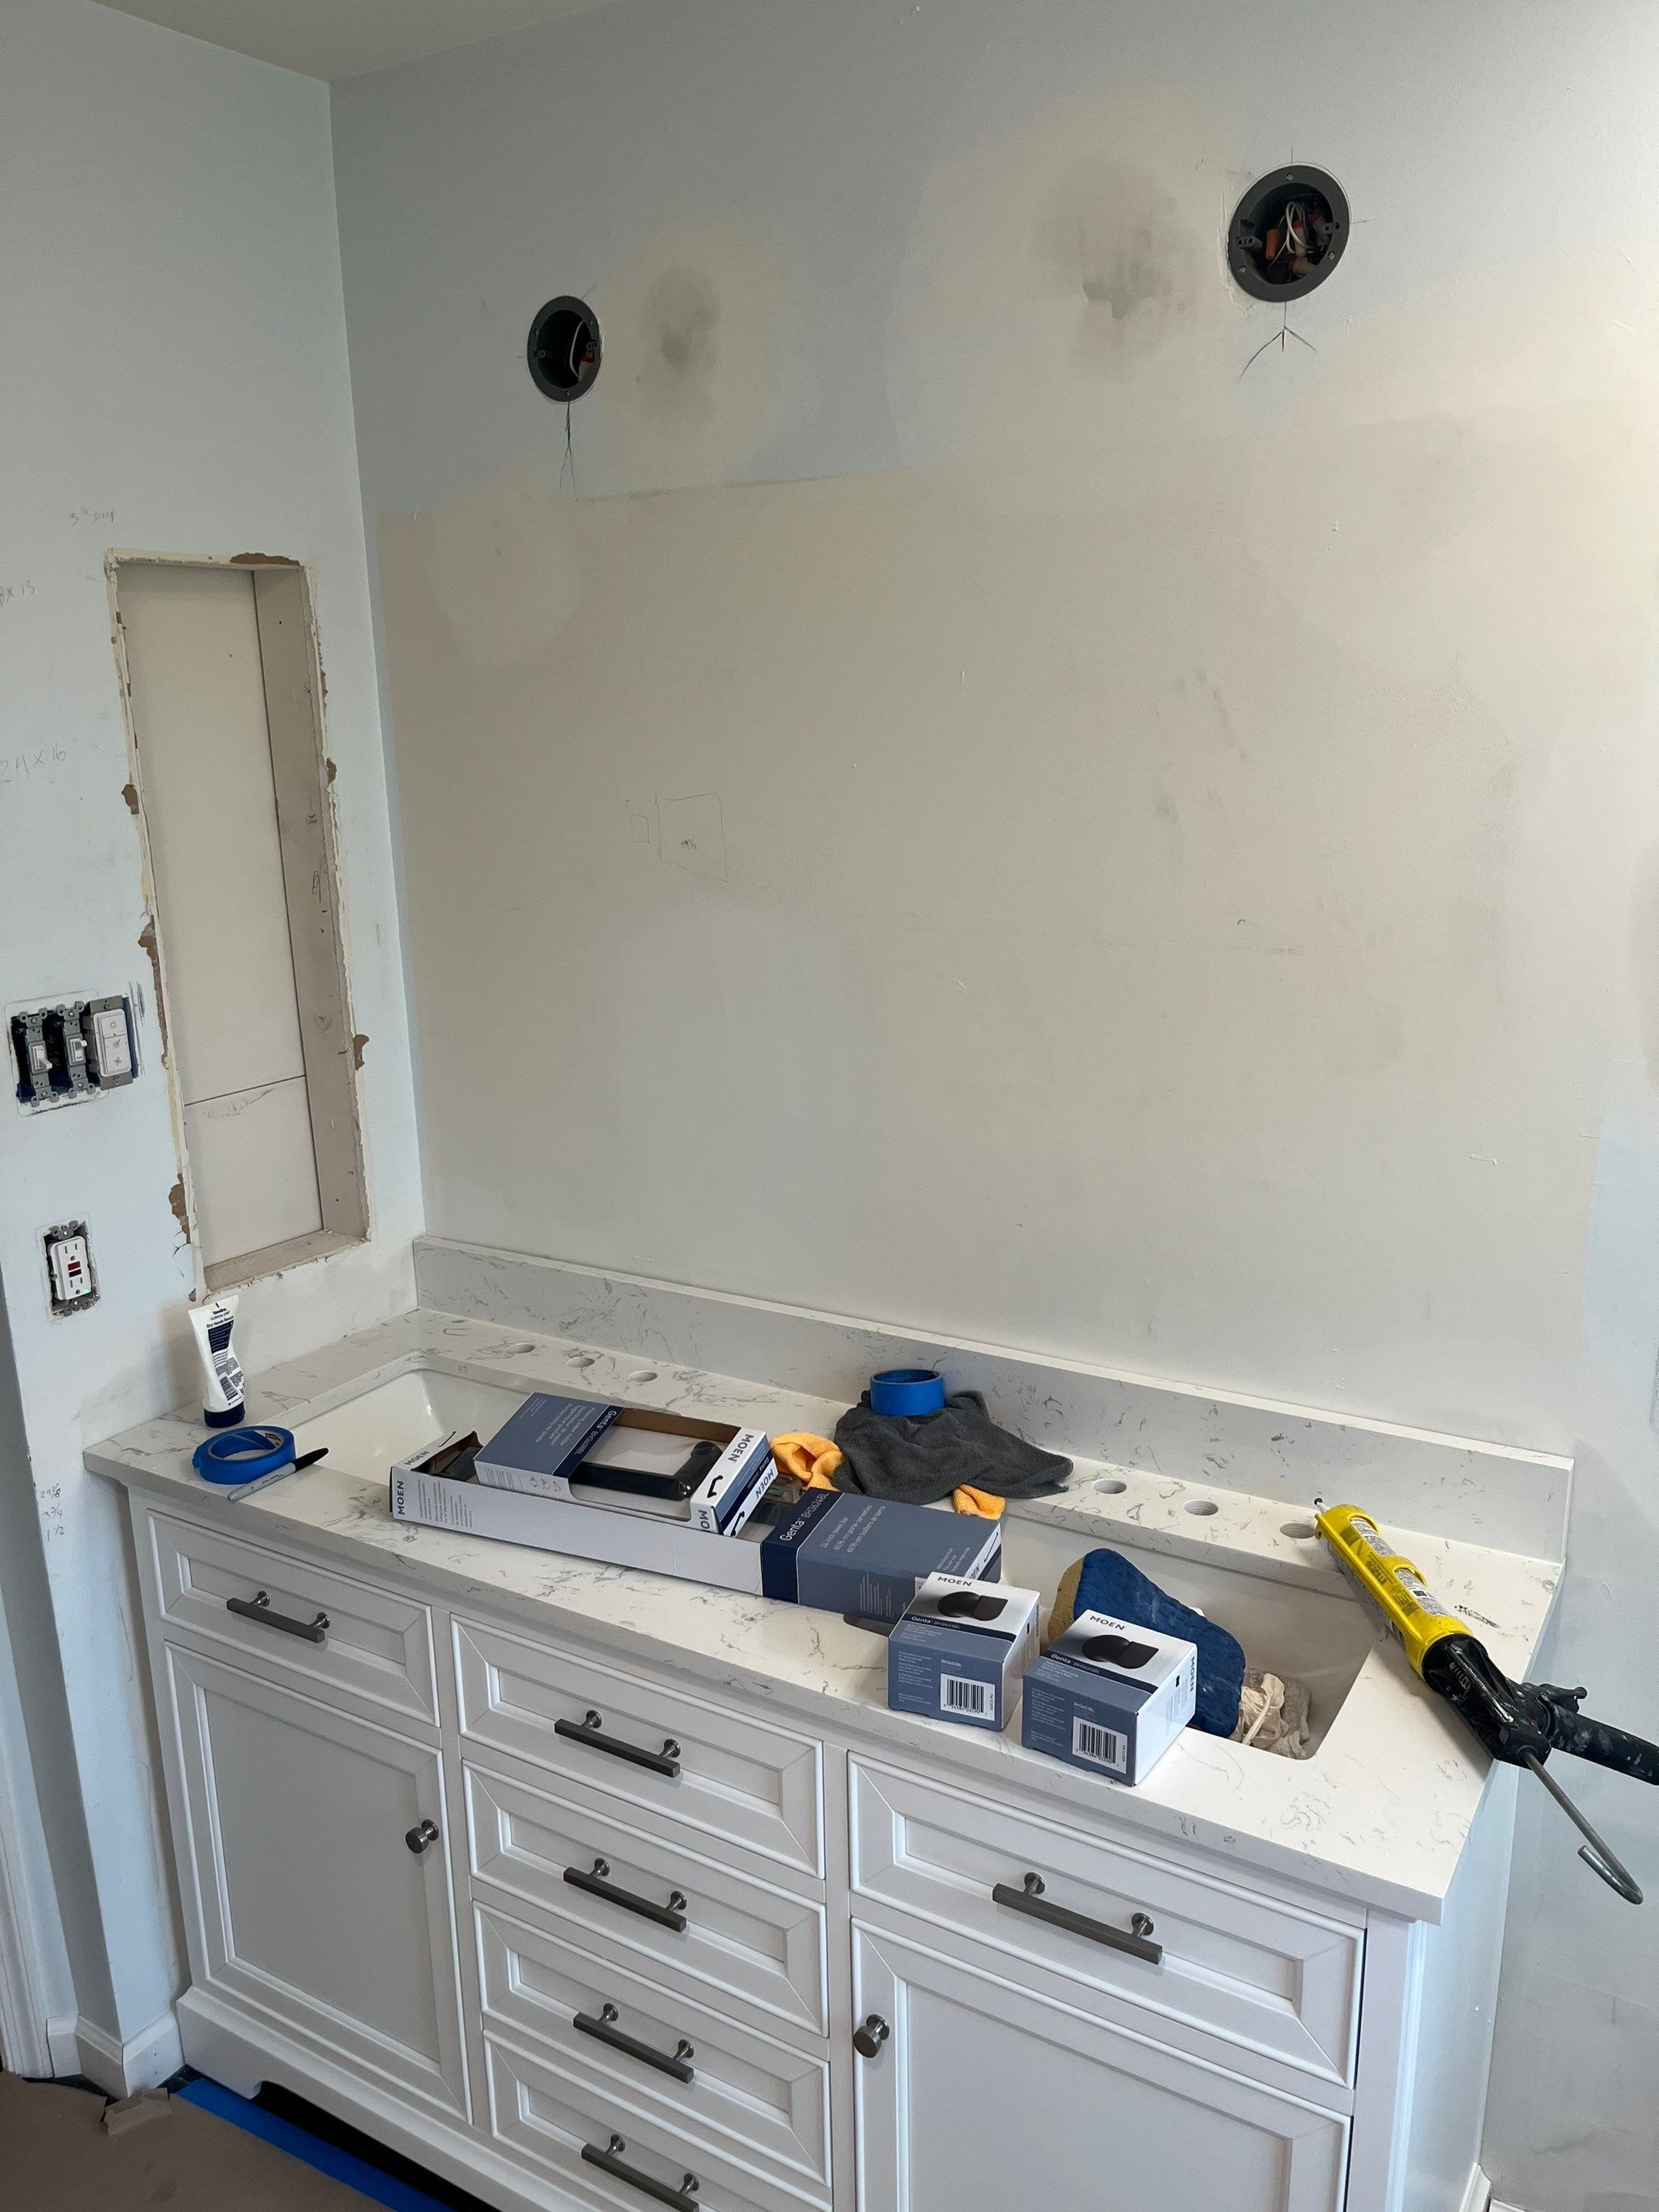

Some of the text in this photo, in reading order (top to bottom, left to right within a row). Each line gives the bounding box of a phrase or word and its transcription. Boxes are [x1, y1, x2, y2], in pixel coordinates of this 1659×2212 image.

[596, 1409, 618, 1429] Genta
[727, 1433, 755, 1463] MOEN
[404, 1450, 431, 1467] MOEN
[754, 1468, 774, 1500] MOEN
[396, 1480, 406, 1515] MOEN
[697, 1509, 710, 1529] MO
[779, 1518, 806, 1541] Genta
[937, 1576, 972, 1587] MOEN
[911, 1615, 932, 1624] Genta
[1089, 1614, 1127, 1631] MOEN
[1051, 1653, 1071, 1664] Genta
